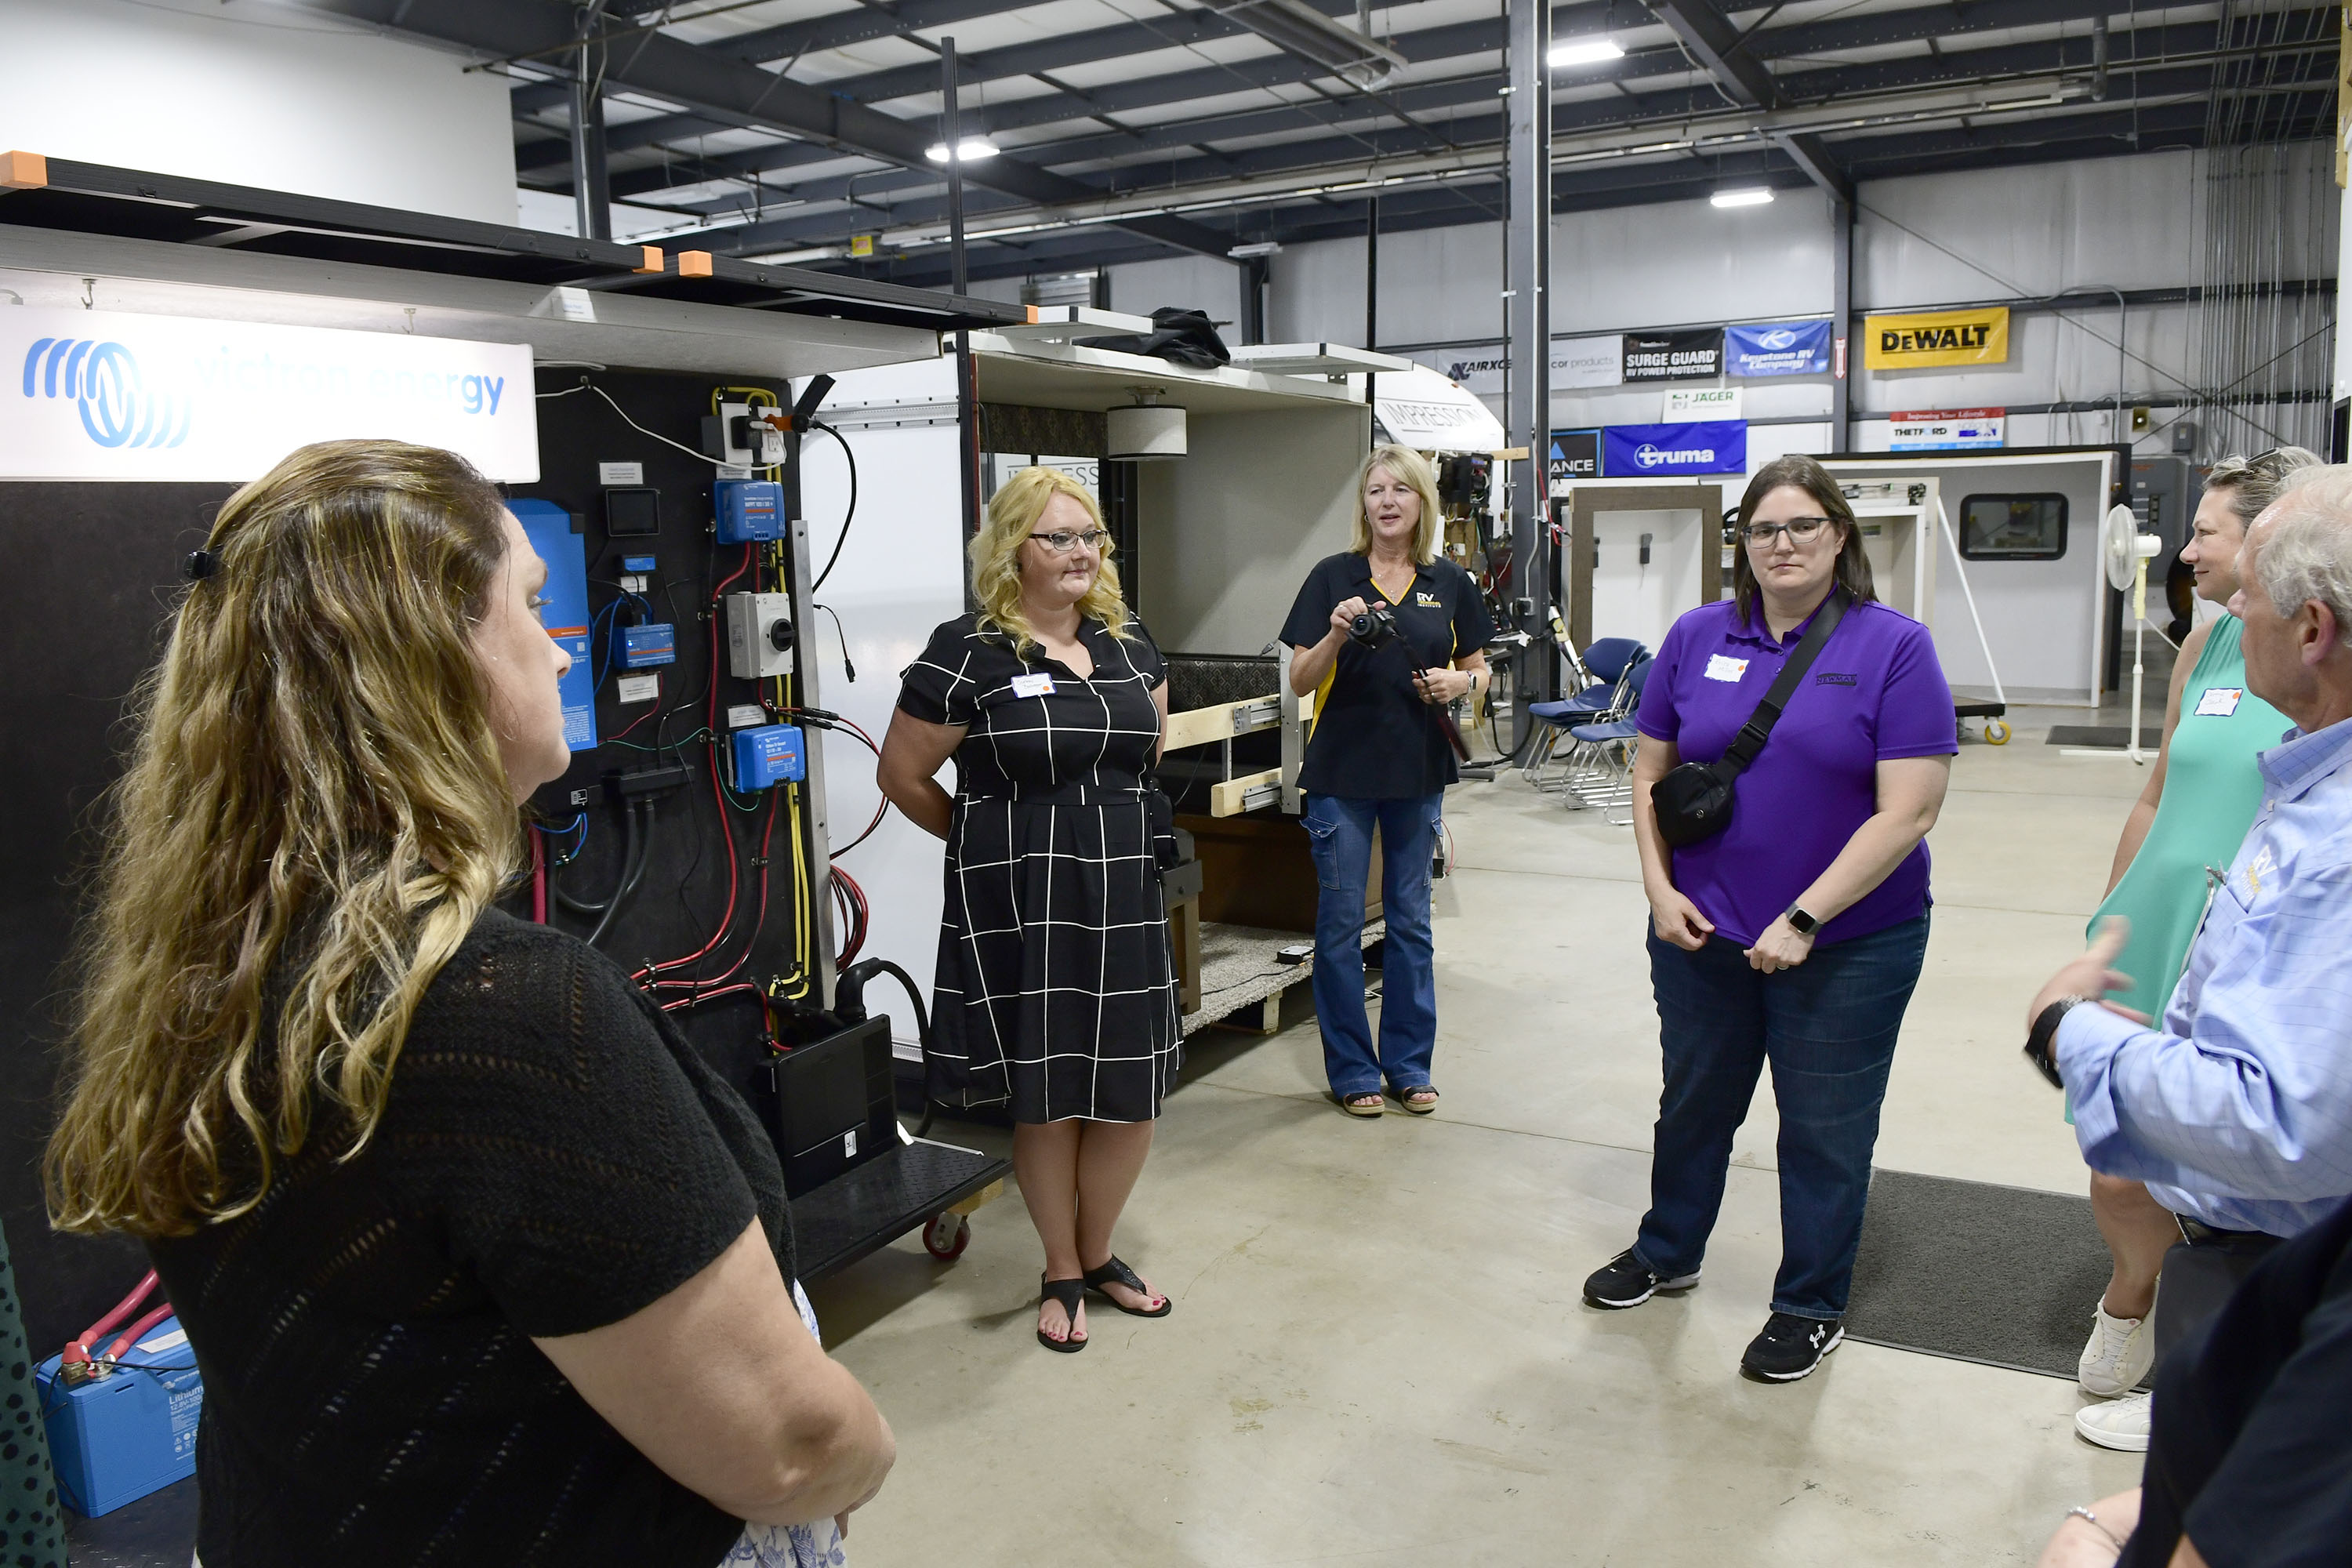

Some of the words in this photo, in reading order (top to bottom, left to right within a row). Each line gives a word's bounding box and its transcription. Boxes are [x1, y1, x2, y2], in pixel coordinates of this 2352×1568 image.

[1882, 327, 1991, 351] DEWALT
[1570, 357, 1614, 368] products
[1626, 354, 1668, 367] SURGE
[1670, 350, 1715, 366] GUARD
[1740, 353, 1796, 363] Keystone
[1797, 349, 1815, 359] RV
[1749, 359, 1806, 370] Company
[1626, 368, 1637, 377] RV
[1638, 366, 1666, 376] POWER
[1667, 365, 1715, 376] PROTECTION
[366, 365, 505, 416] energy
[1381, 403, 1482, 427] IMPRESSION
[1639, 445, 1715, 467] truma
[1417, 592, 1434, 601] RV
[169, 1385, 204, 1405] Lithium
